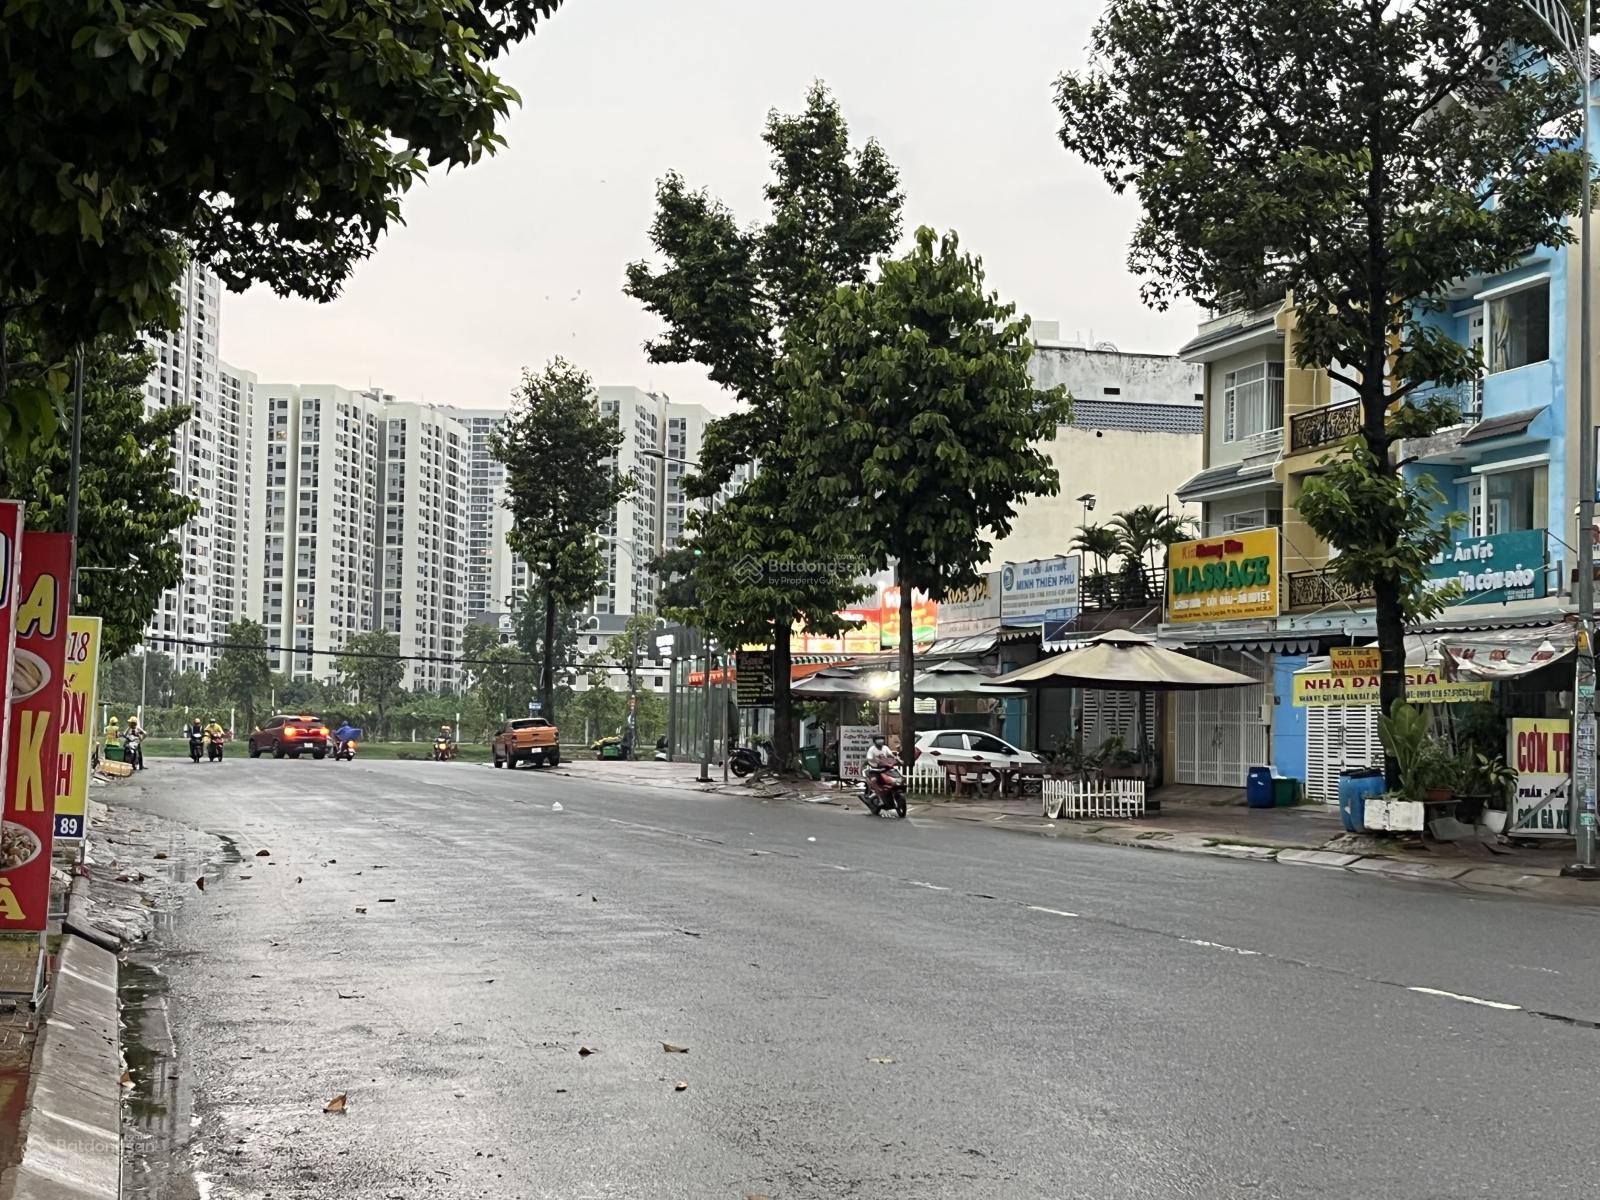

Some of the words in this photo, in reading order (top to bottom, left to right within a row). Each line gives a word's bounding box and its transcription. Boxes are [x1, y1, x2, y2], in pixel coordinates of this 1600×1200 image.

[1172, 556, 1270, 594] MASSAGE
[1333, 657, 1354, 670] NHÀ
[844, 766, 859, 776] 79K
[60, 817, 78, 835] 89
